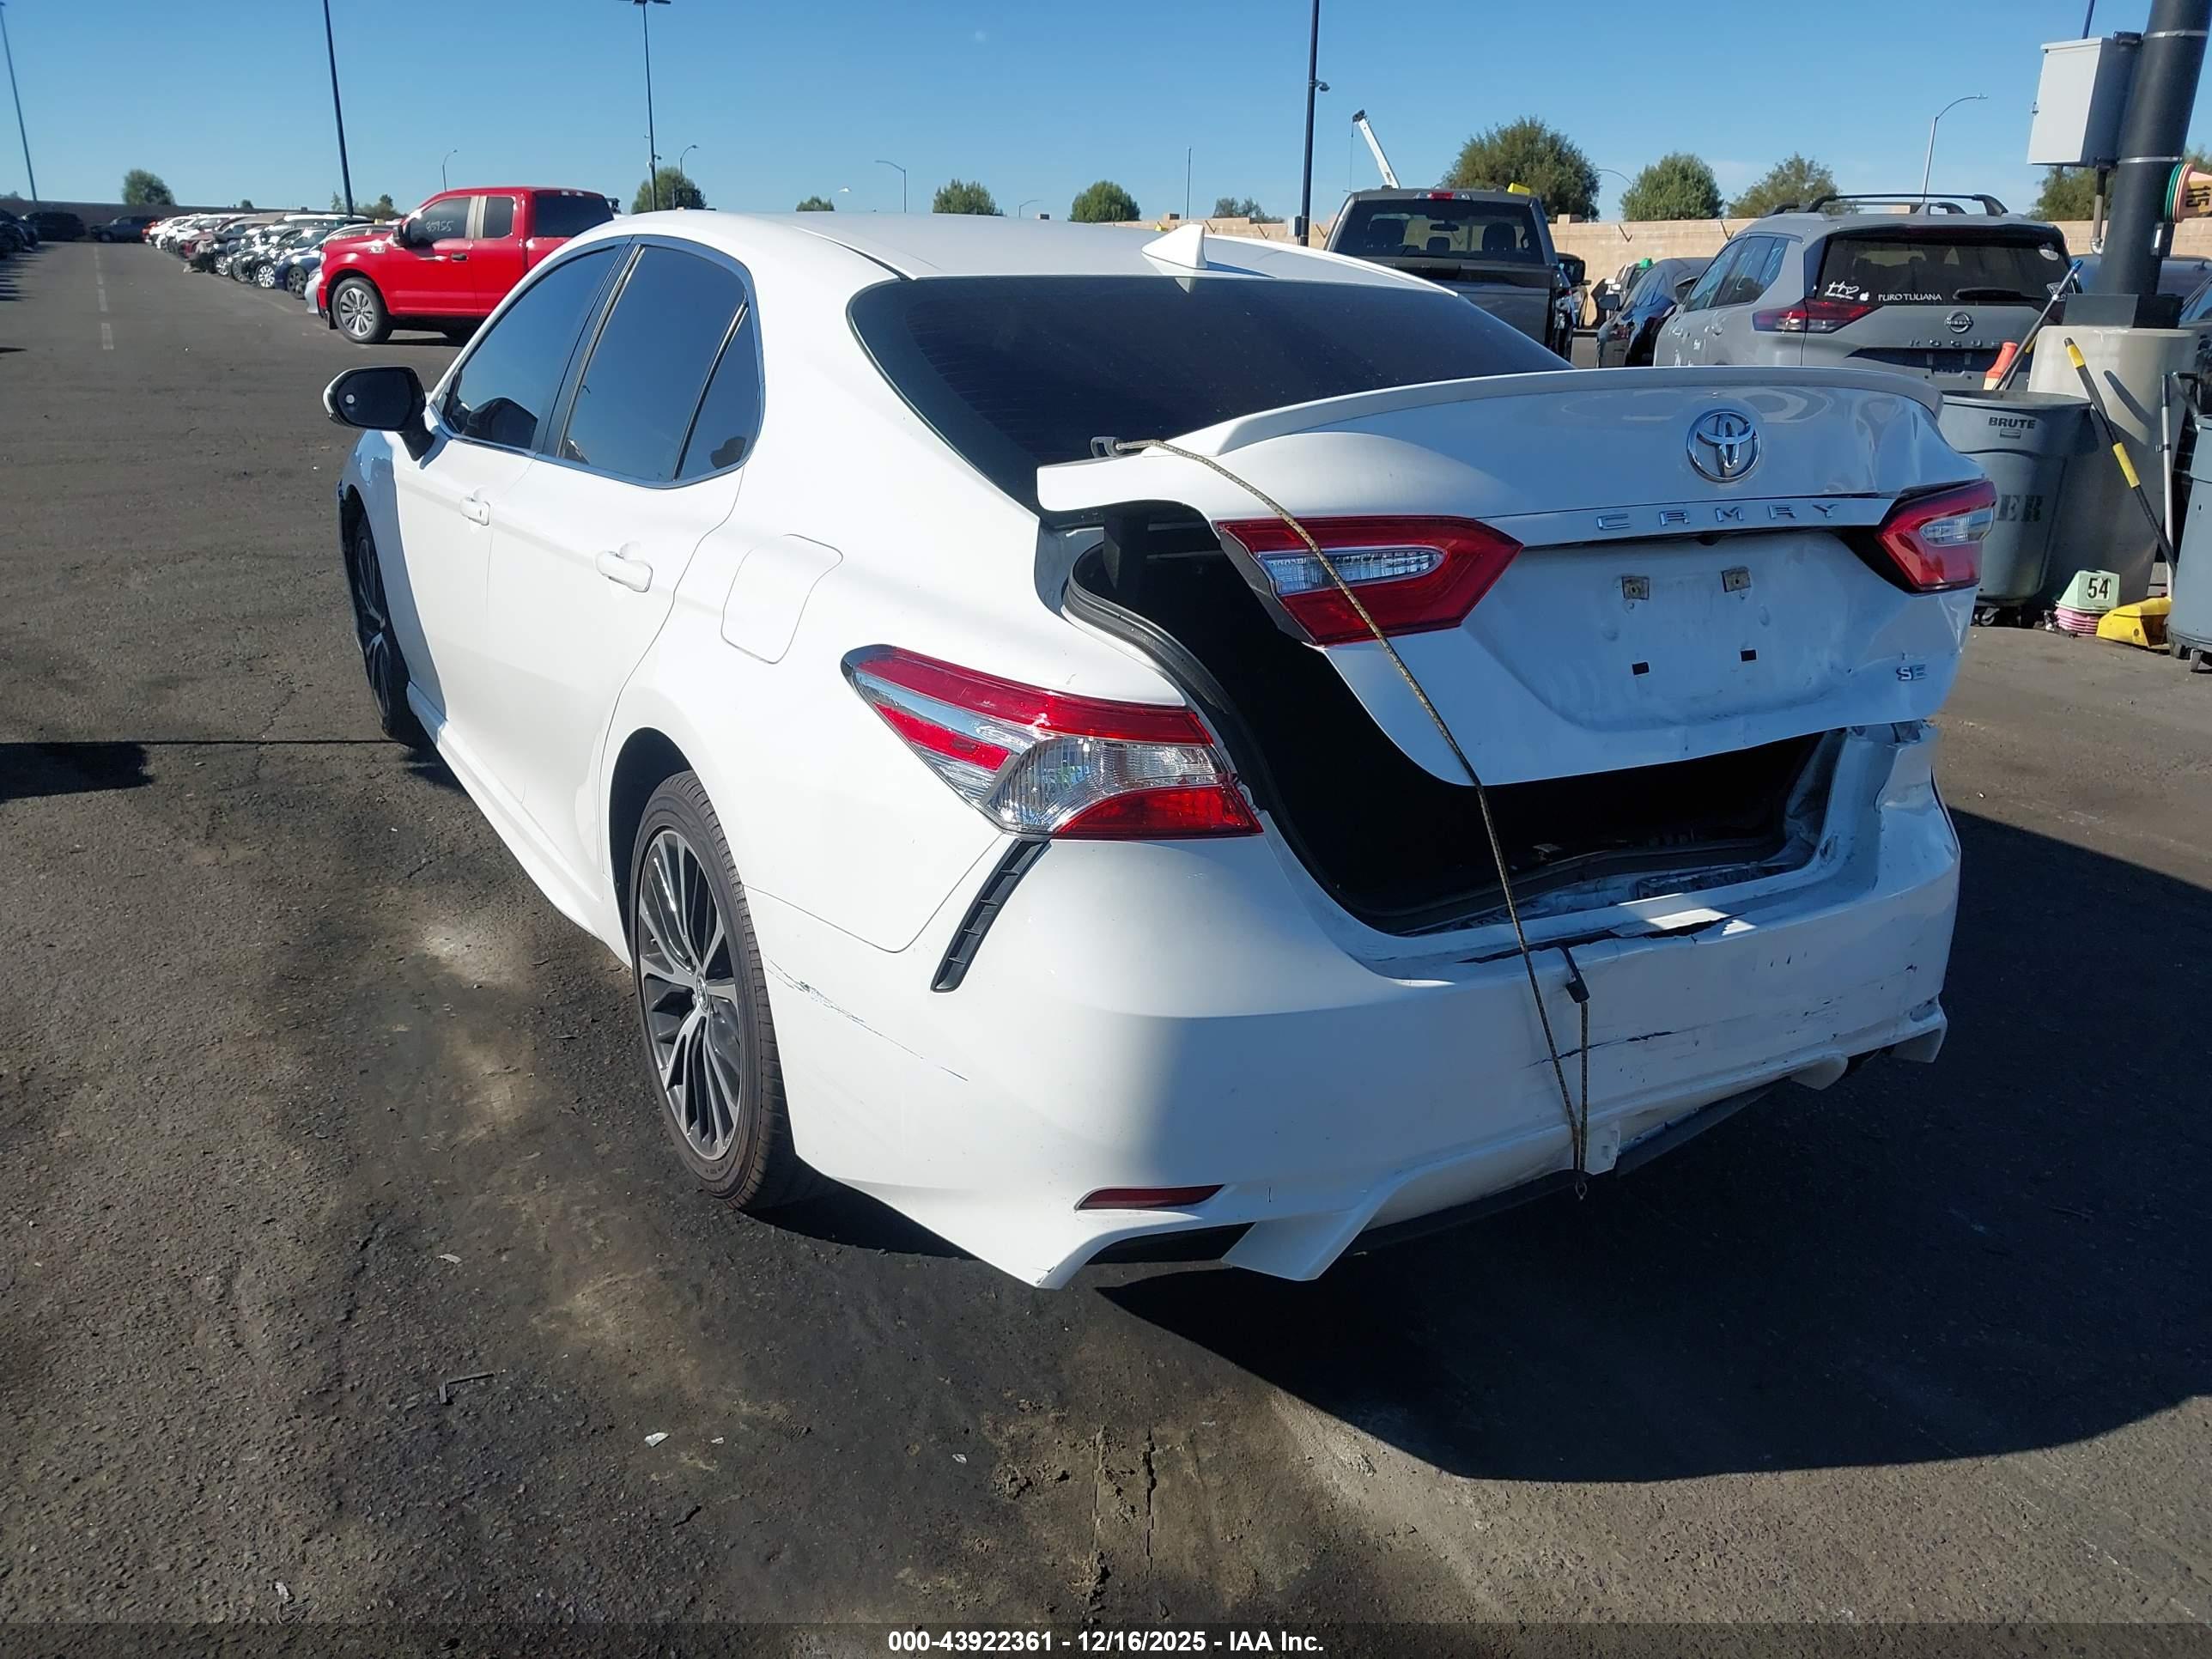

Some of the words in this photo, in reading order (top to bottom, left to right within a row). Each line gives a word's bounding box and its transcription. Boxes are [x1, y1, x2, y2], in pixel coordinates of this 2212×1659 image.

[2185, 185, 2211, 208] 115
[1989, 416, 2036, 429] BRUTE
[1596, 503, 1839, 530] CAMRY
[2087, 577, 2111, 599] 54
[1896, 664, 1927, 681] SE
